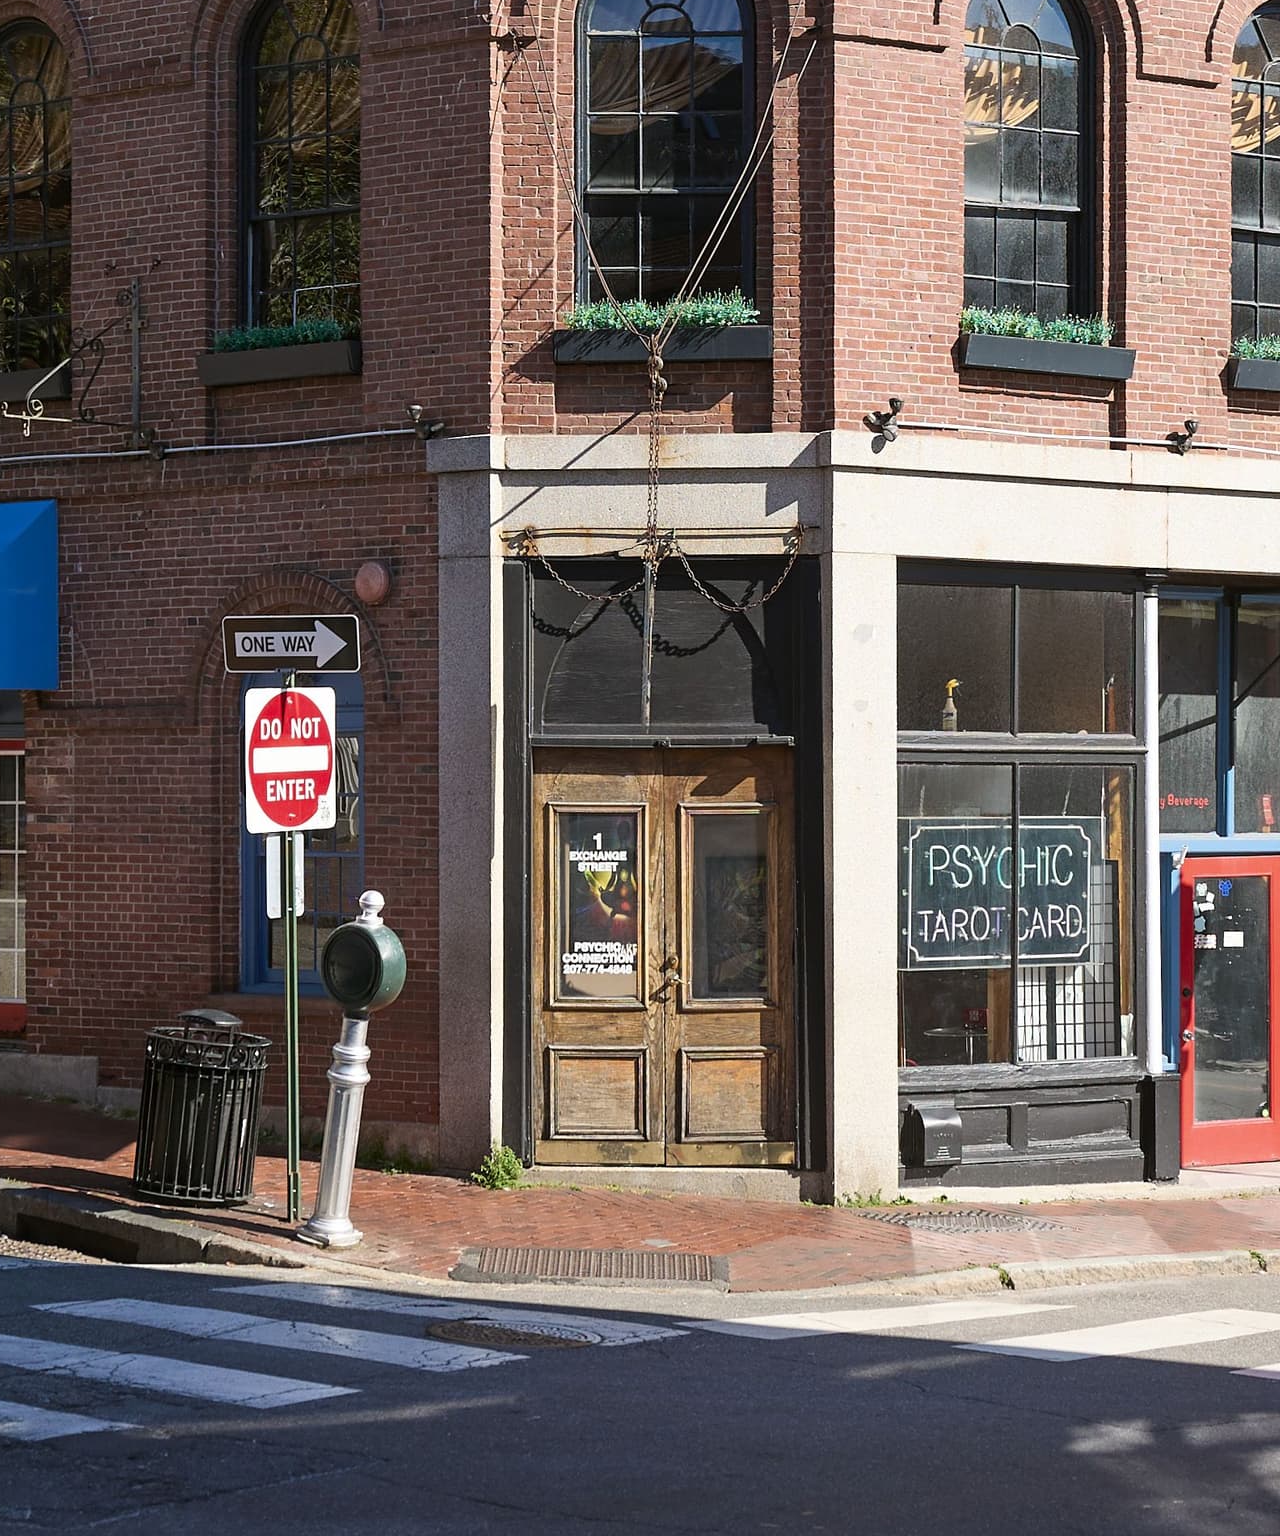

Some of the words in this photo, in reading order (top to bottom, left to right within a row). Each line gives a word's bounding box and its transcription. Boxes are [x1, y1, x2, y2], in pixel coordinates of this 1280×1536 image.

[240, 636, 275, 653] ONE
[282, 635, 316, 652] WAY
[260, 718, 282, 740] DO
[291, 717, 321, 739] NOT
[266, 778, 316, 802] ENTER
[1167, 793, 1210, 809] Beverage
[592, 832, 602, 850] 1
[569, 850, 628, 862] EXCHANGE
[577, 861, 619, 872] STREET
[929, 844, 1074, 889] PSYCHIC
[917, 906, 1006, 943] TAROT
[1016, 903, 1083, 942] CARD
[573, 941, 621, 953] PSYCHIC
[561, 952, 635, 964] CONNECTION
